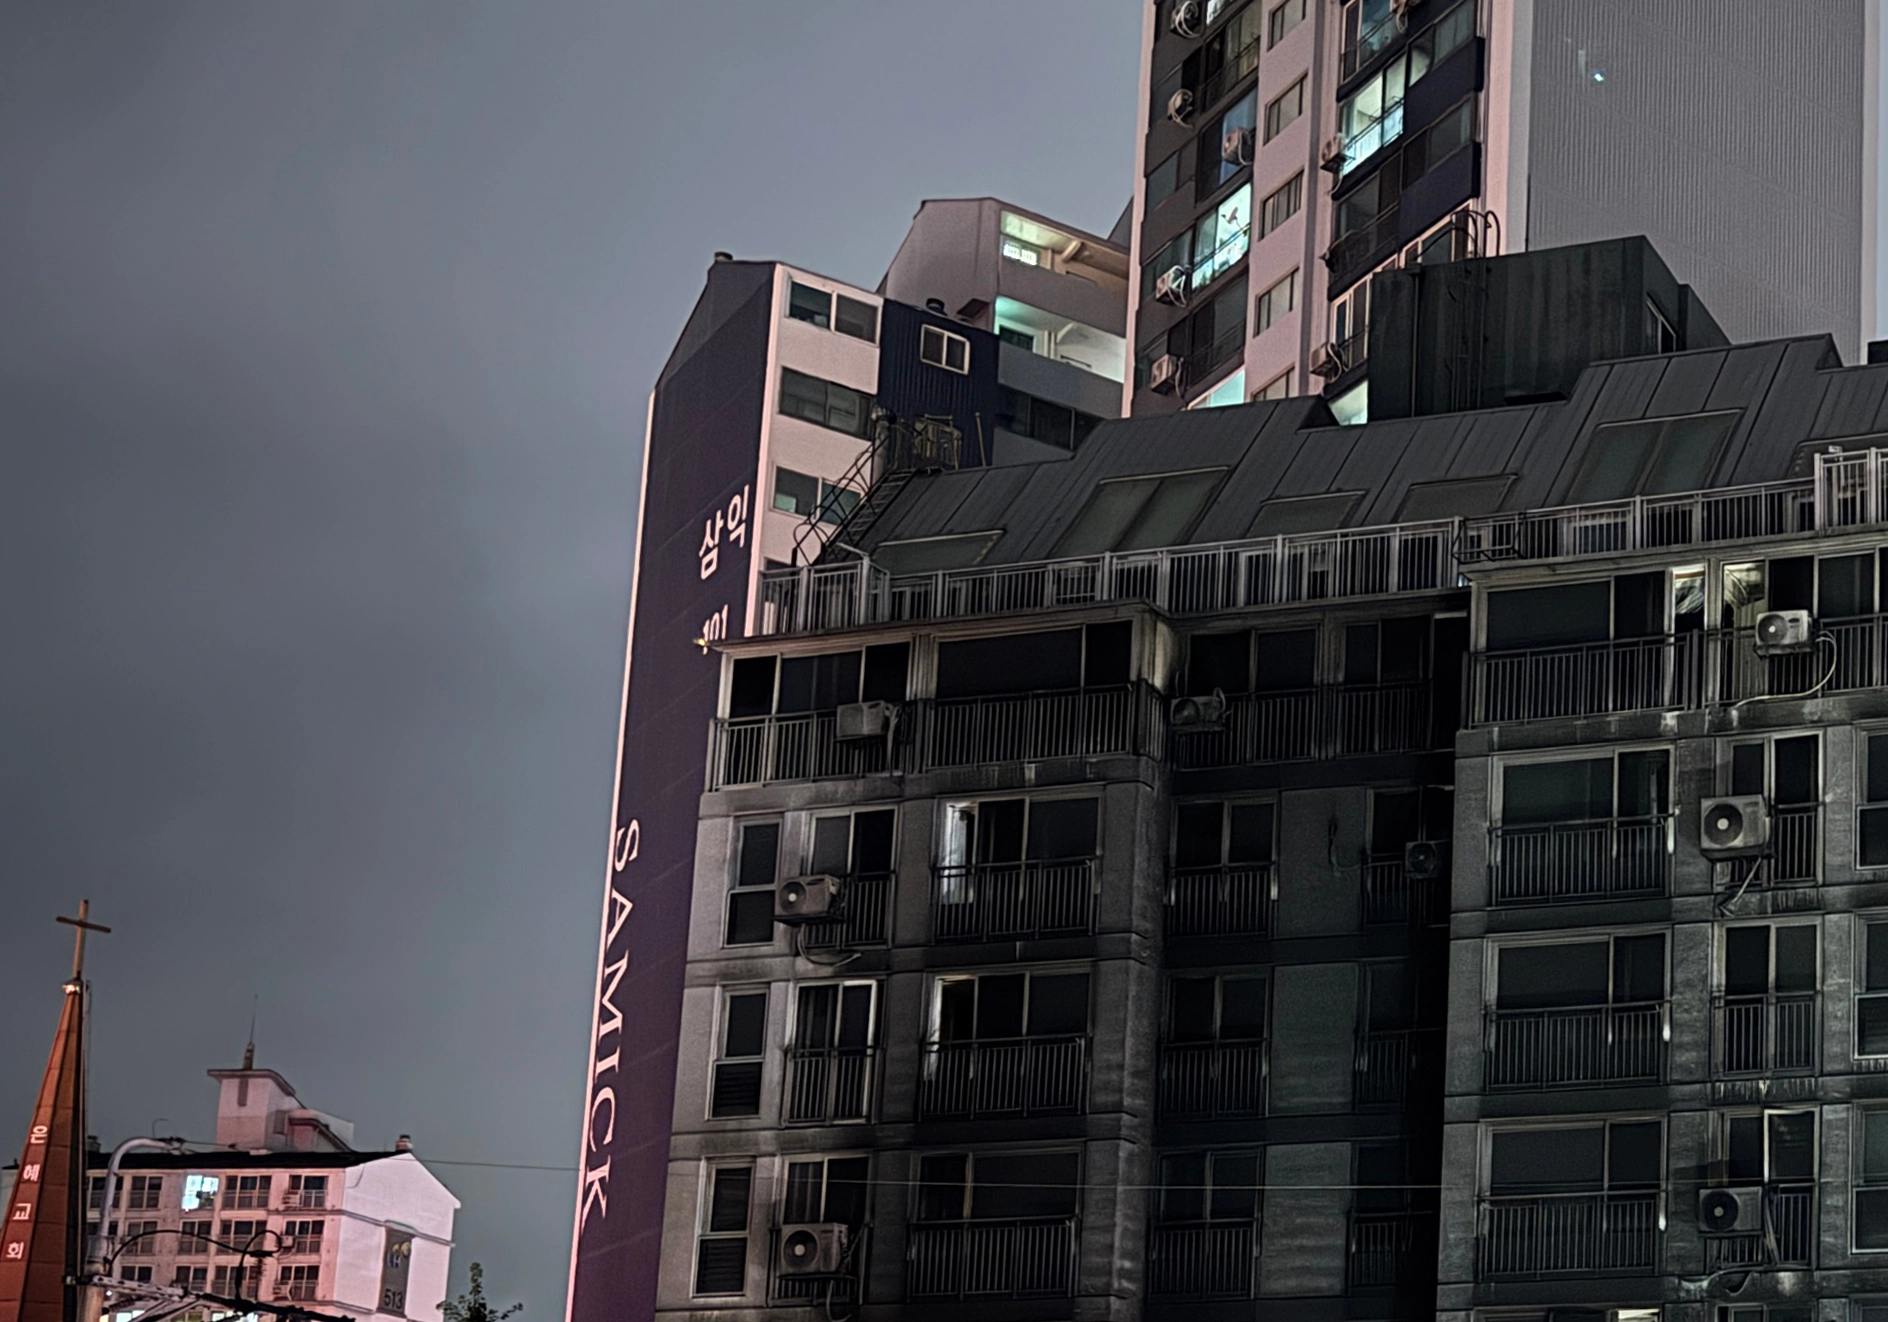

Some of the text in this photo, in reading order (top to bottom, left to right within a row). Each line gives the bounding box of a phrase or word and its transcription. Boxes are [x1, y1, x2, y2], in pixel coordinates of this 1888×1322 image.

[699, 484, 750, 580] 삼익
[585, 819, 640, 1219] SAMICK
[6, 1125, 48, 1260] 은혜교회
